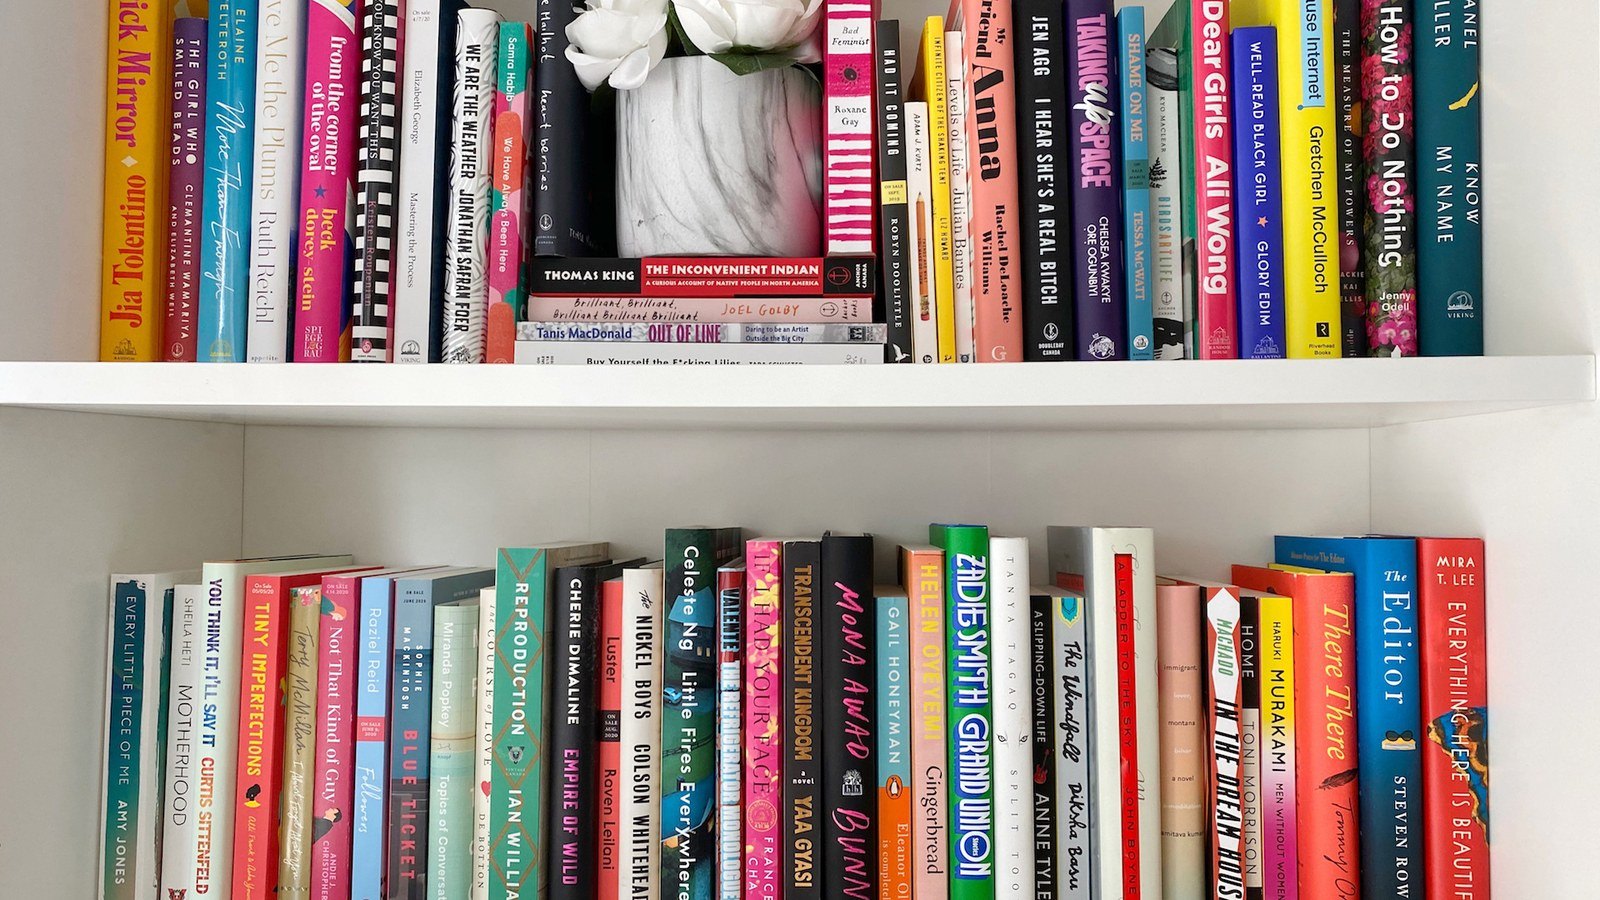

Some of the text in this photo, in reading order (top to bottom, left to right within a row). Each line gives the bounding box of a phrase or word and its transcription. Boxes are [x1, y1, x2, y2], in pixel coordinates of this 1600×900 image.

[189, 40, 200, 68] THE
[832, 38, 870, 46] Feminist
[1032, 17, 1050, 76] JEN AGG
[1379, 7, 1402, 64] How
[115, 49, 151, 147] Mirror
[173, 38, 184, 165] SMILED BEADS
[188, 80, 199, 118] GIRL
[410, 70, 423, 145] Elizabeth George
[834, 106, 867, 114] Roxane
[842, 117, 859, 127] Gay
[972, 63, 1004, 182] Anna
[1036, 110, 1052, 148] HEAR
[1128, 34, 1143, 142] SHAME ON ME
[1381, 74, 1402, 101] to
[454, 44, 481, 332] WE ARE THE WEATHER JONATHAN SAFRAN FOER
[1037, 154, 1054, 197] SHE'S
[1202, 1, 1230, 295] Dear Girls Ali Wong
[1250, 42, 1270, 325] WELL-READ BLACK GIRL GLORY EDIM
[1436, 147, 1453, 243] MY NAME
[1466, 163, 1479, 224] KNOW
[112, 174, 146, 285] Tolentino
[1038, 203, 1055, 214] A
[1039, 219, 1056, 256] REAL
[1309, 126, 1328, 293] Gretchen McCulloch
[1378, 160, 1406, 267] Nothing
[109, 291, 143, 328] Jia
[180, 184, 193, 339] CLEMANTINE WAMARIYA
[255, 212, 277, 323] Ruth Reichl
[544, 270, 635, 281] THOMAS KING
[646, 265, 819, 275] THE INCONVENIENT INDIAN
[721, 304, 800, 316] JOEL GOLBY
[890, 219, 902, 328] ROBYN DOOLITTLE
[982, 230, 992, 295] Williams
[995, 205, 1012, 323] Rachel DeLoache
[1040, 262, 1058, 305] BITCH
[1379, 292, 1411, 302] Jenny
[1382, 303, 1409, 311] Odell
[537, 328, 632, 339] Tanis MacDonald
[649, 325, 721, 342] OUT OF LINE
[1384, 571, 1407, 582] The
[1436, 557, 1475, 567] MIRA
[1437, 574, 1474, 585] T. LEE
[247, 603, 270, 776] TINY IMPERFECTIONS
[402, 627, 411, 710] MACKINTOSH
[415, 645, 423, 692] SOPHIE
[511, 583, 529, 735] REPRODUCTION
[606, 637, 620, 683] Luster
[678, 546, 700, 773] Celeste Ng Little Fires
[794, 565, 813, 760] TRANSCENDENT KINGDOM
[888, 607, 900, 763] GAIL HONEYMAN
[921, 565, 940, 739] HELEN OYEYEMI
[1271, 622, 1286, 772] HARUKI MURAKAMI
[1324, 604, 1353, 760] There There
[1383, 591, 1412, 705] Editor
[115, 597, 136, 884] EVERY LITTLE PIECE OF ME AMY JONES
[173, 598, 193, 826] SHEILA HETI MOTHERHOOD
[322, 627, 343, 803] Not That Kind of Guy
[562, 579, 582, 886] CHERIE DIMALINE EMPIRE OF WILD
[633, 615, 652, 804] NICKEL BOYS COLSON
[956, 554, 991, 876] ZADIE SMITH GRAND UNION
[1241, 626, 1257, 875] HOME TONI MORRISON
[400, 730, 418, 879] BLUE TICKET
[602, 769, 616, 870] Raven Leilani
[795, 796, 813, 887] YAA GYASI
[921, 766, 943, 875] Gingerbread
